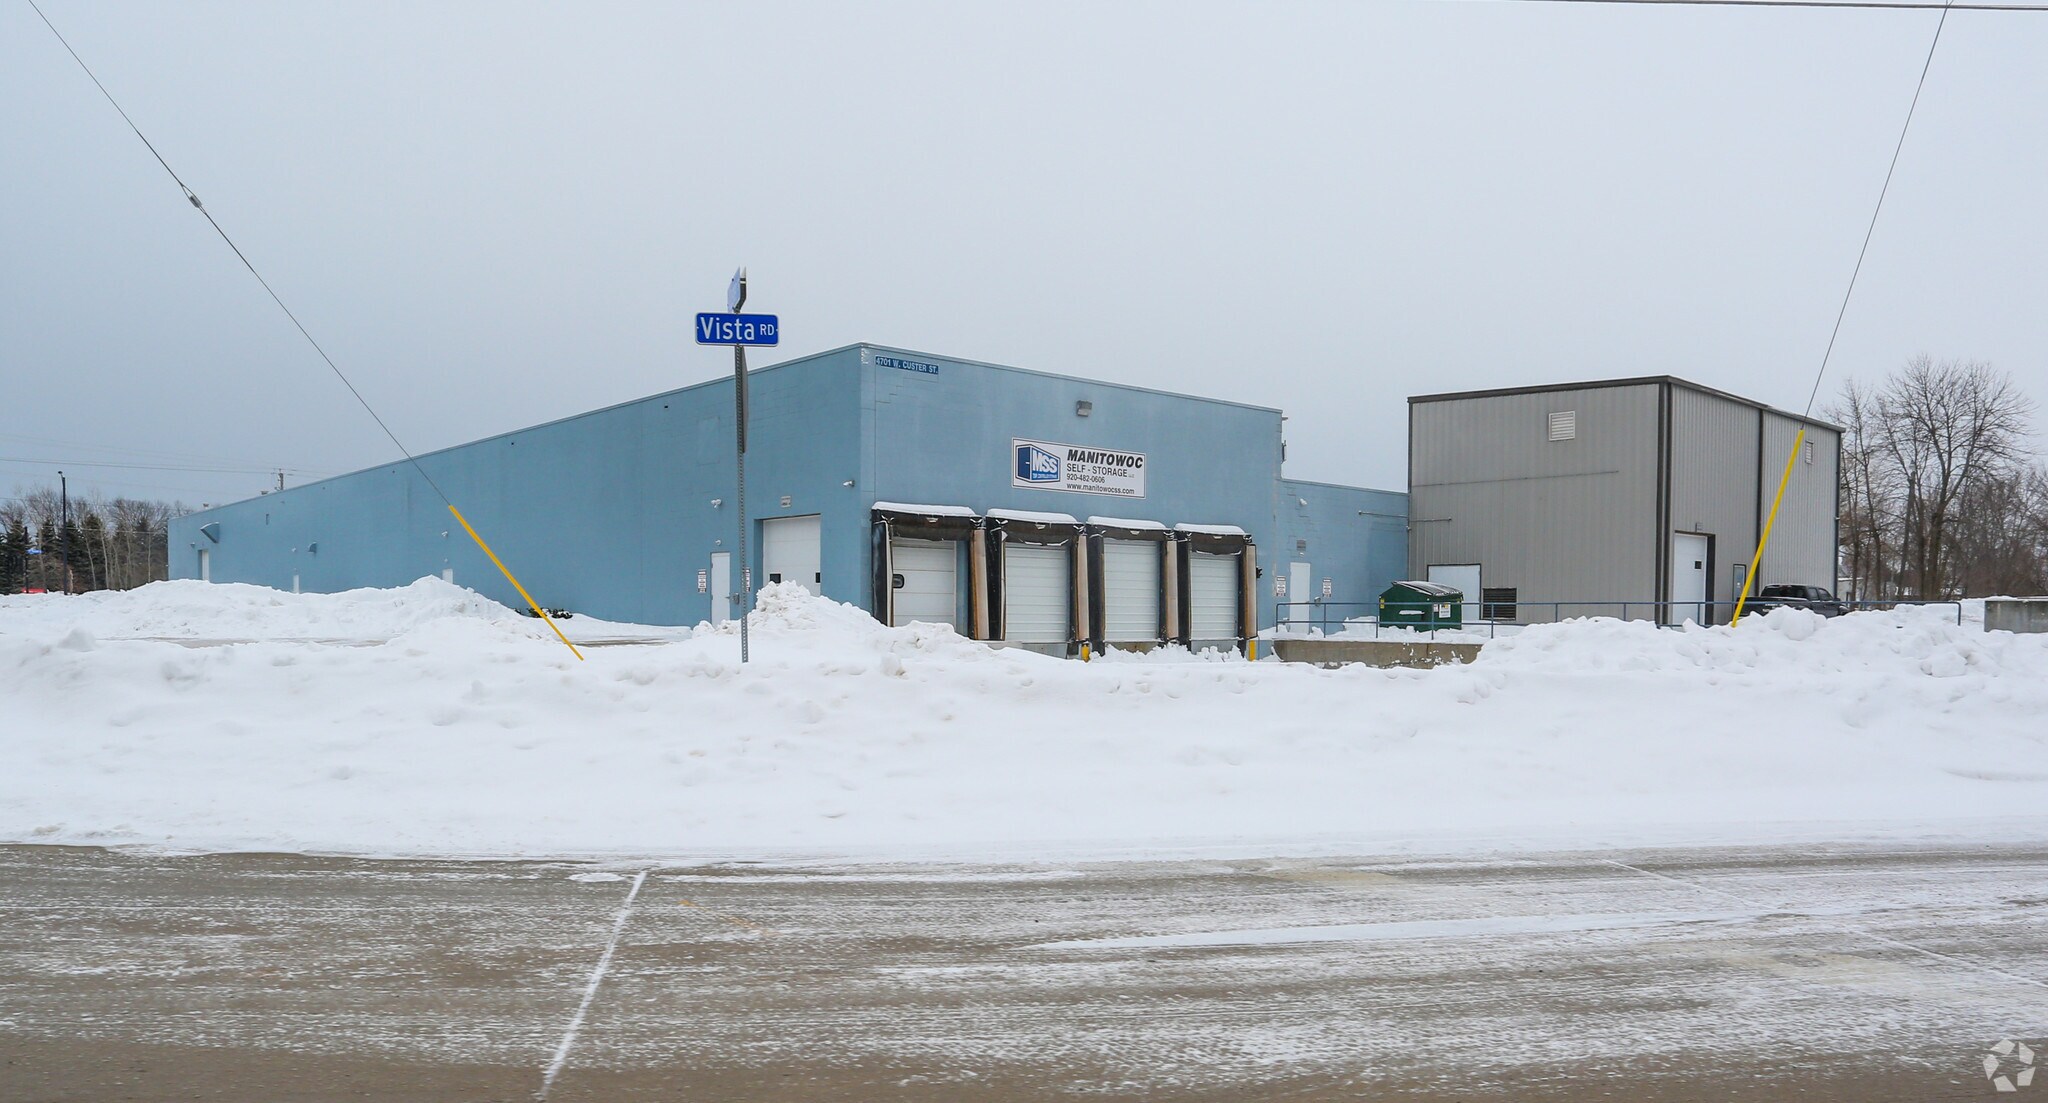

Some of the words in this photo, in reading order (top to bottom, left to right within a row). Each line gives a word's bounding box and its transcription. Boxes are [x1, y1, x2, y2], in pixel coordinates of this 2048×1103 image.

[700, 316, 755, 341] Vista
[760, 323, 775, 336] RD
[876, 357, 891, 367] 4701
[902, 361, 927, 372] CUSTER
[928, 365, 938, 374] ST.
[1032, 449, 1058, 474] MSS
[1067, 449, 1143, 469] MANITOWOC
[1066, 462, 1086, 473] SELF
[1092, 466, 1128, 478] STORAGE
[1066, 473, 1106, 484] 920-482-0606
[1066, 483, 1135, 495] www.manitowocss.com
